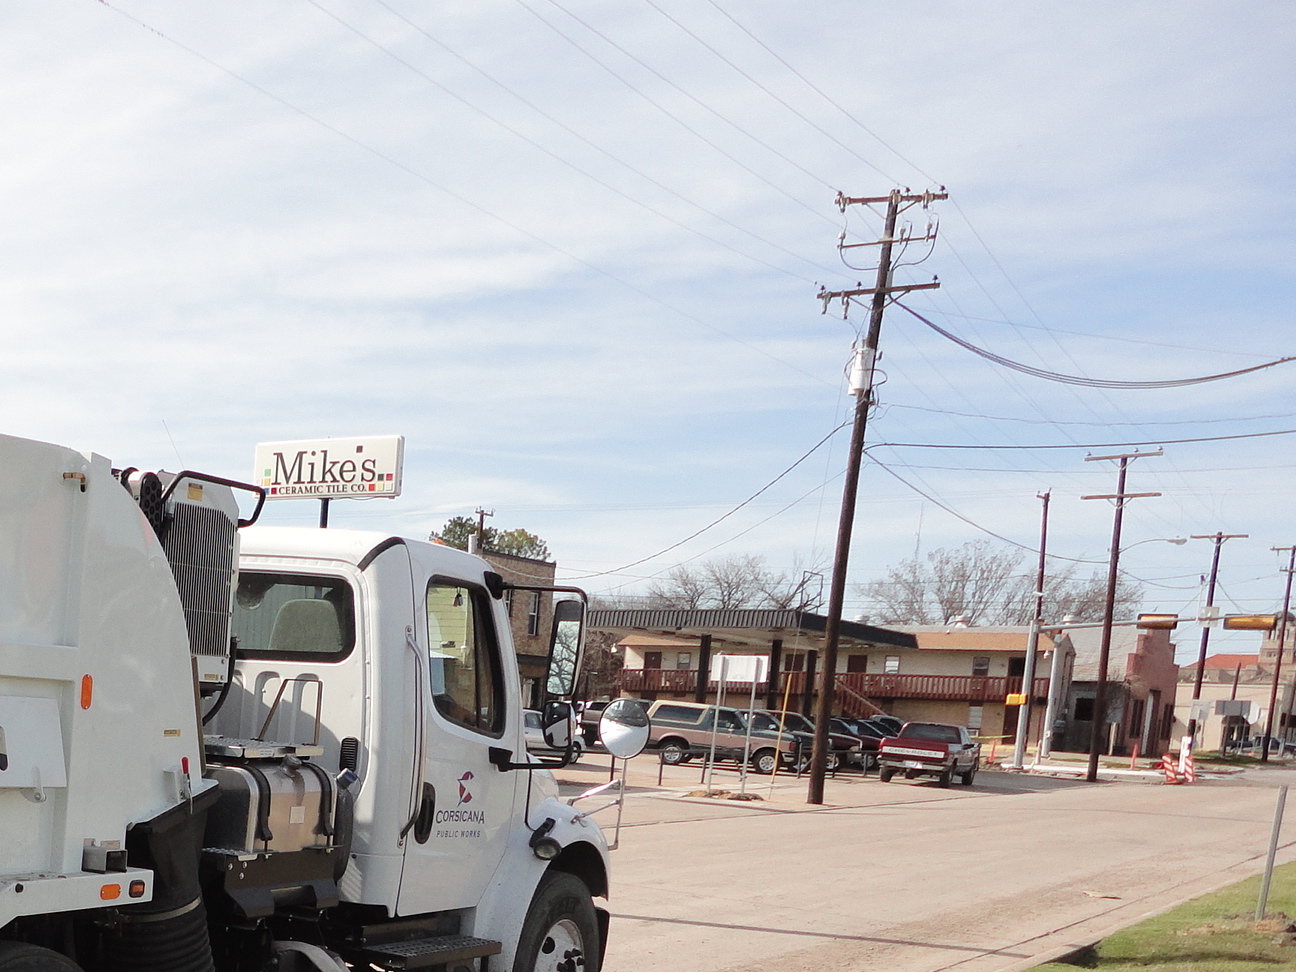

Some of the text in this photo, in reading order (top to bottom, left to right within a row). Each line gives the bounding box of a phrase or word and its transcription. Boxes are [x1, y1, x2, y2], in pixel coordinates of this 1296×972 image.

[271, 445, 376, 485] Mike's
[278, 483, 367, 495] CERAMIC TILE CO.
[435, 810, 485, 824] CORSICANA
[436, 830, 481, 838] PUBLIC WORKS
